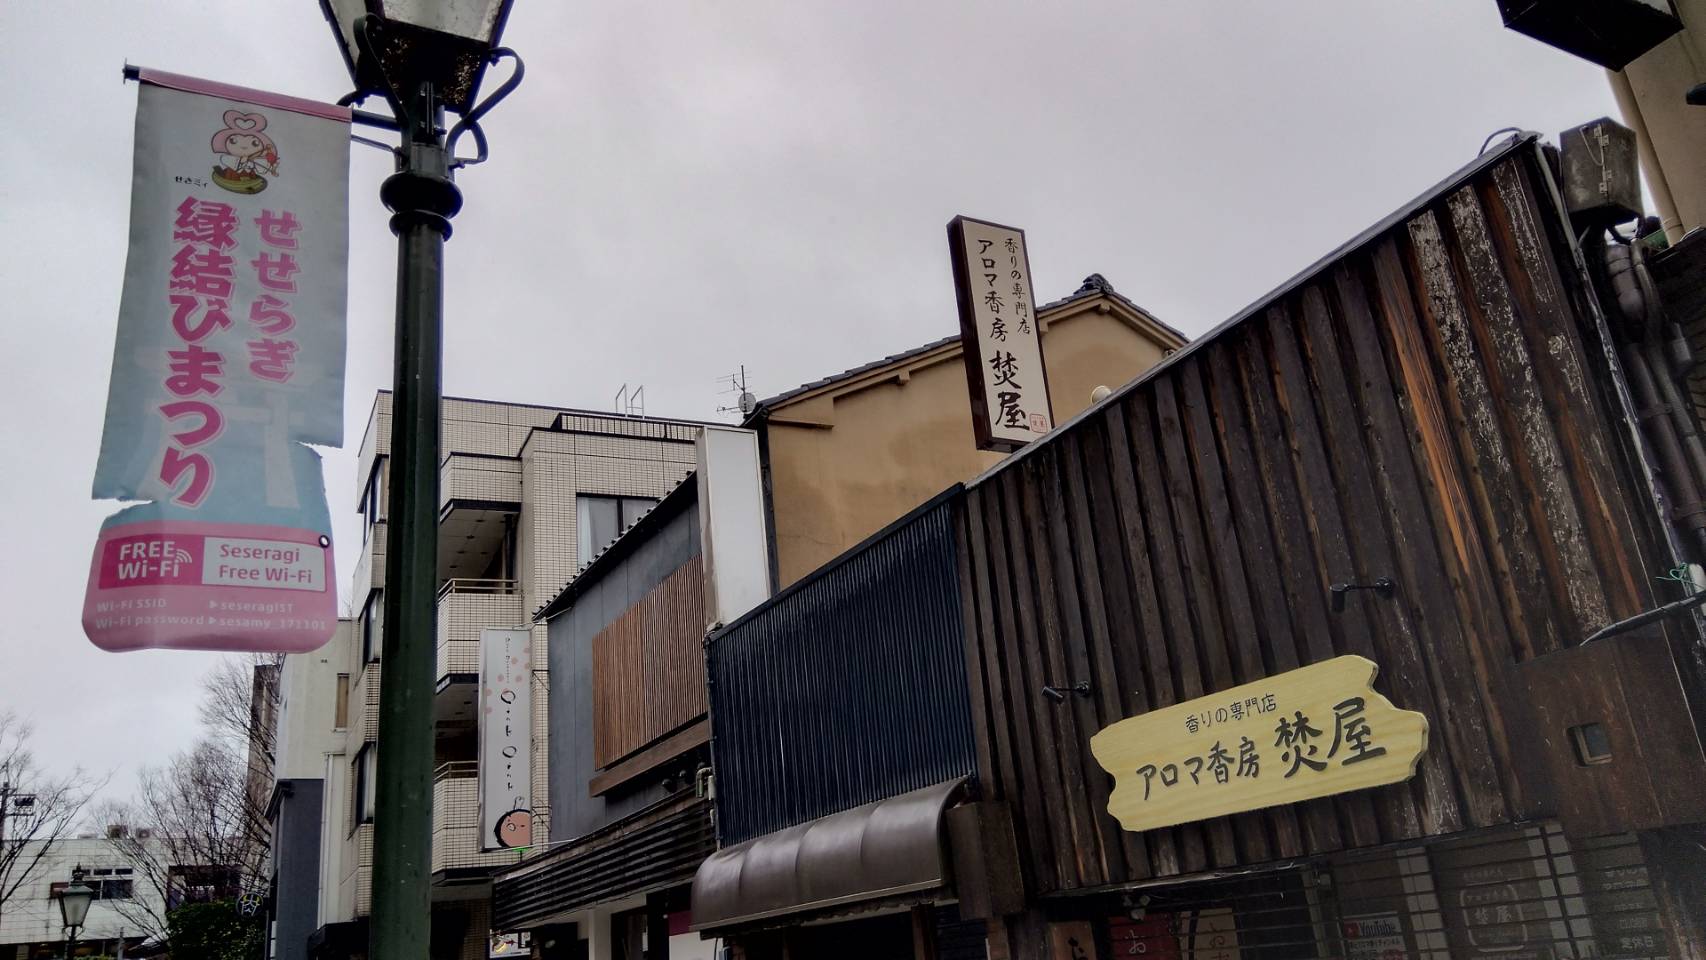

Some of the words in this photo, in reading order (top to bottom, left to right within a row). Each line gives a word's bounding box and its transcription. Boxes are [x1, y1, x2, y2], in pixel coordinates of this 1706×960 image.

[246, 208, 302, 384] せせらぎ
[977, 238, 1009, 342] アロマ香房
[1004, 237, 1031, 335] 香りの専門店
[158, 196, 240, 508] 縁結びまつり
[988, 349, 1030, 431] 焚屋
[117, 561, 180, 580] Wi-Fi
[119, 540, 175, 560] FREE
[220, 543, 300, 565] Seseragi
[219, 564, 260, 580] Free
[265, 567, 312, 583] Wi-Fi
[135, 615, 204, 627] password
[136, 598, 167, 609] SSID
[1185, 692, 1277, 734] 香りの専門店
[1136, 736, 1260, 801] アロマ香房
[1273, 696, 1387, 779] 焚屋
